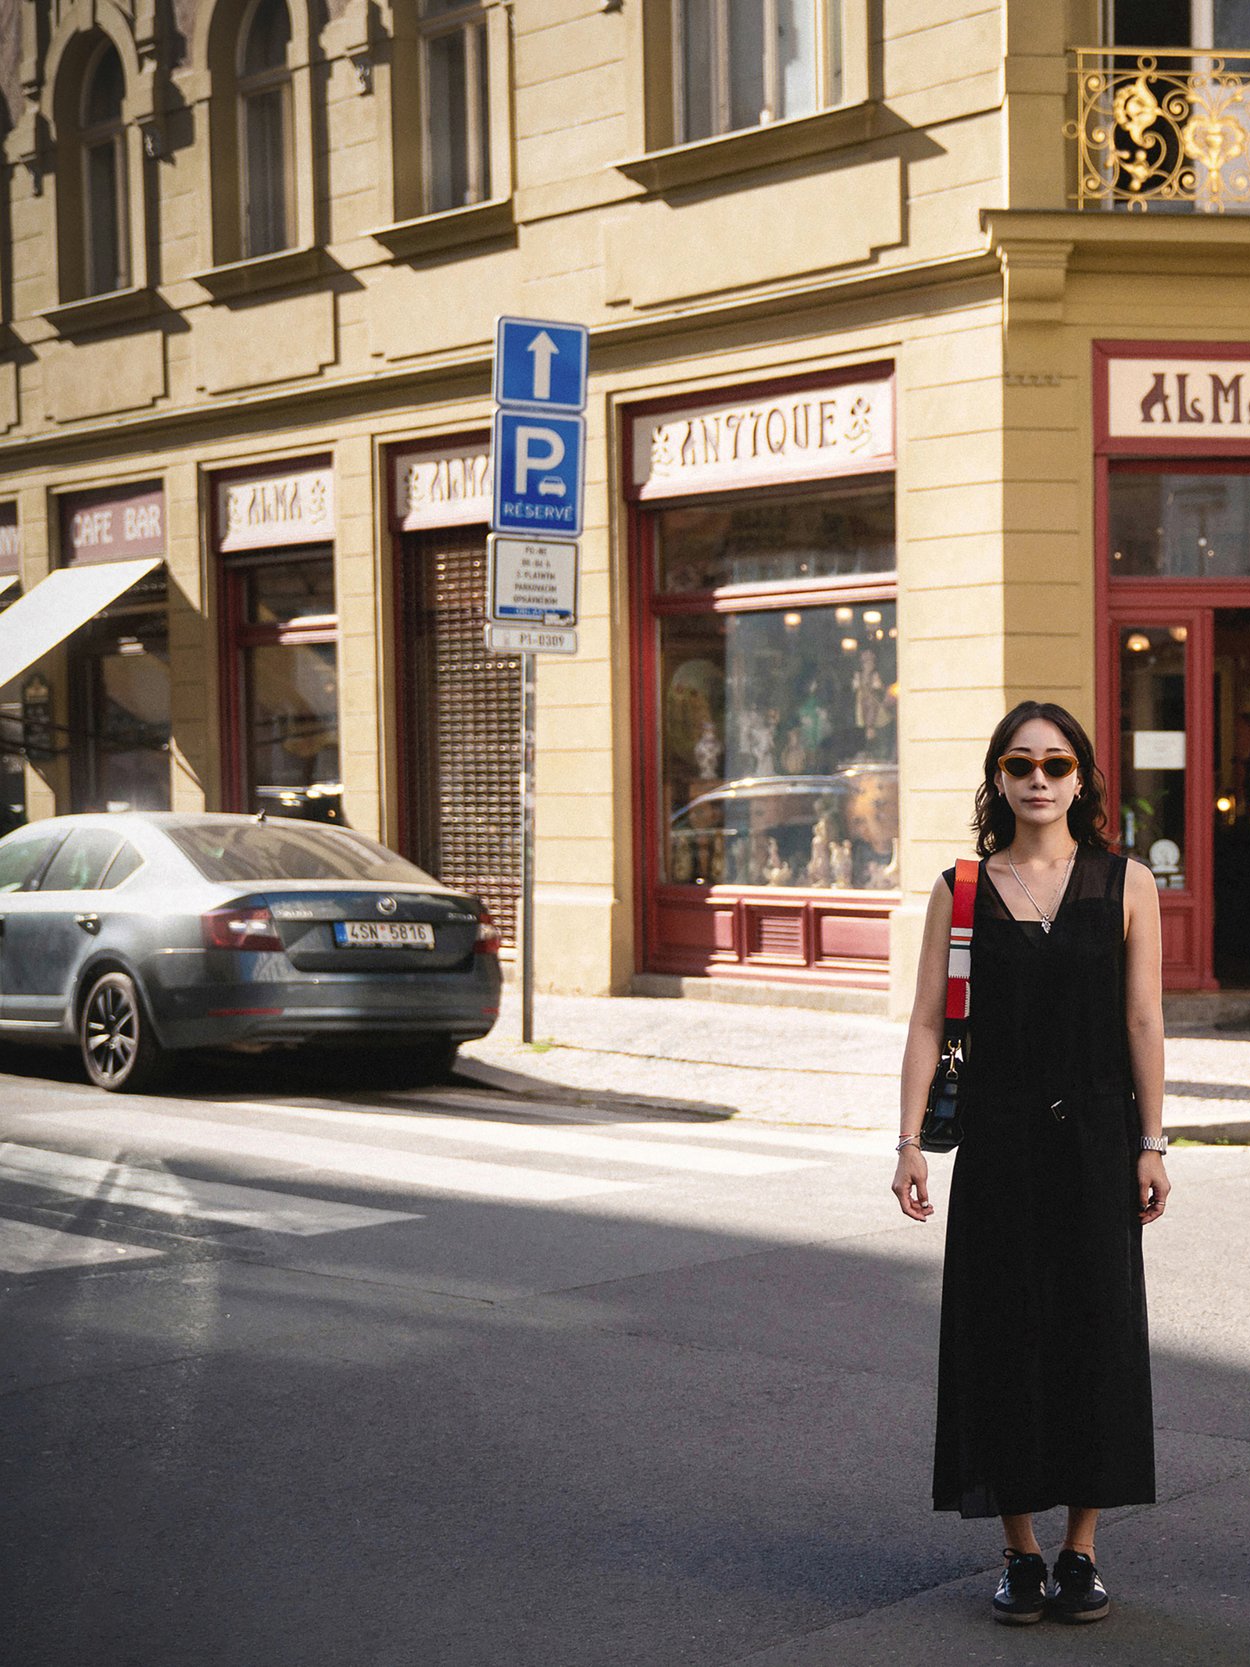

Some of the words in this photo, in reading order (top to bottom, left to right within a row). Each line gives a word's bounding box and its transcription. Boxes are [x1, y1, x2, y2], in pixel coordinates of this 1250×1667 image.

[681, 400, 837, 466] ANTIQUE
[515, 425, 565, 496] P
[124, 504, 162, 541] BAR
[503, 502, 574, 521] RÉSERVÉ
[350, 925, 379, 940] 4SN
[390, 924, 427, 940] 5816
